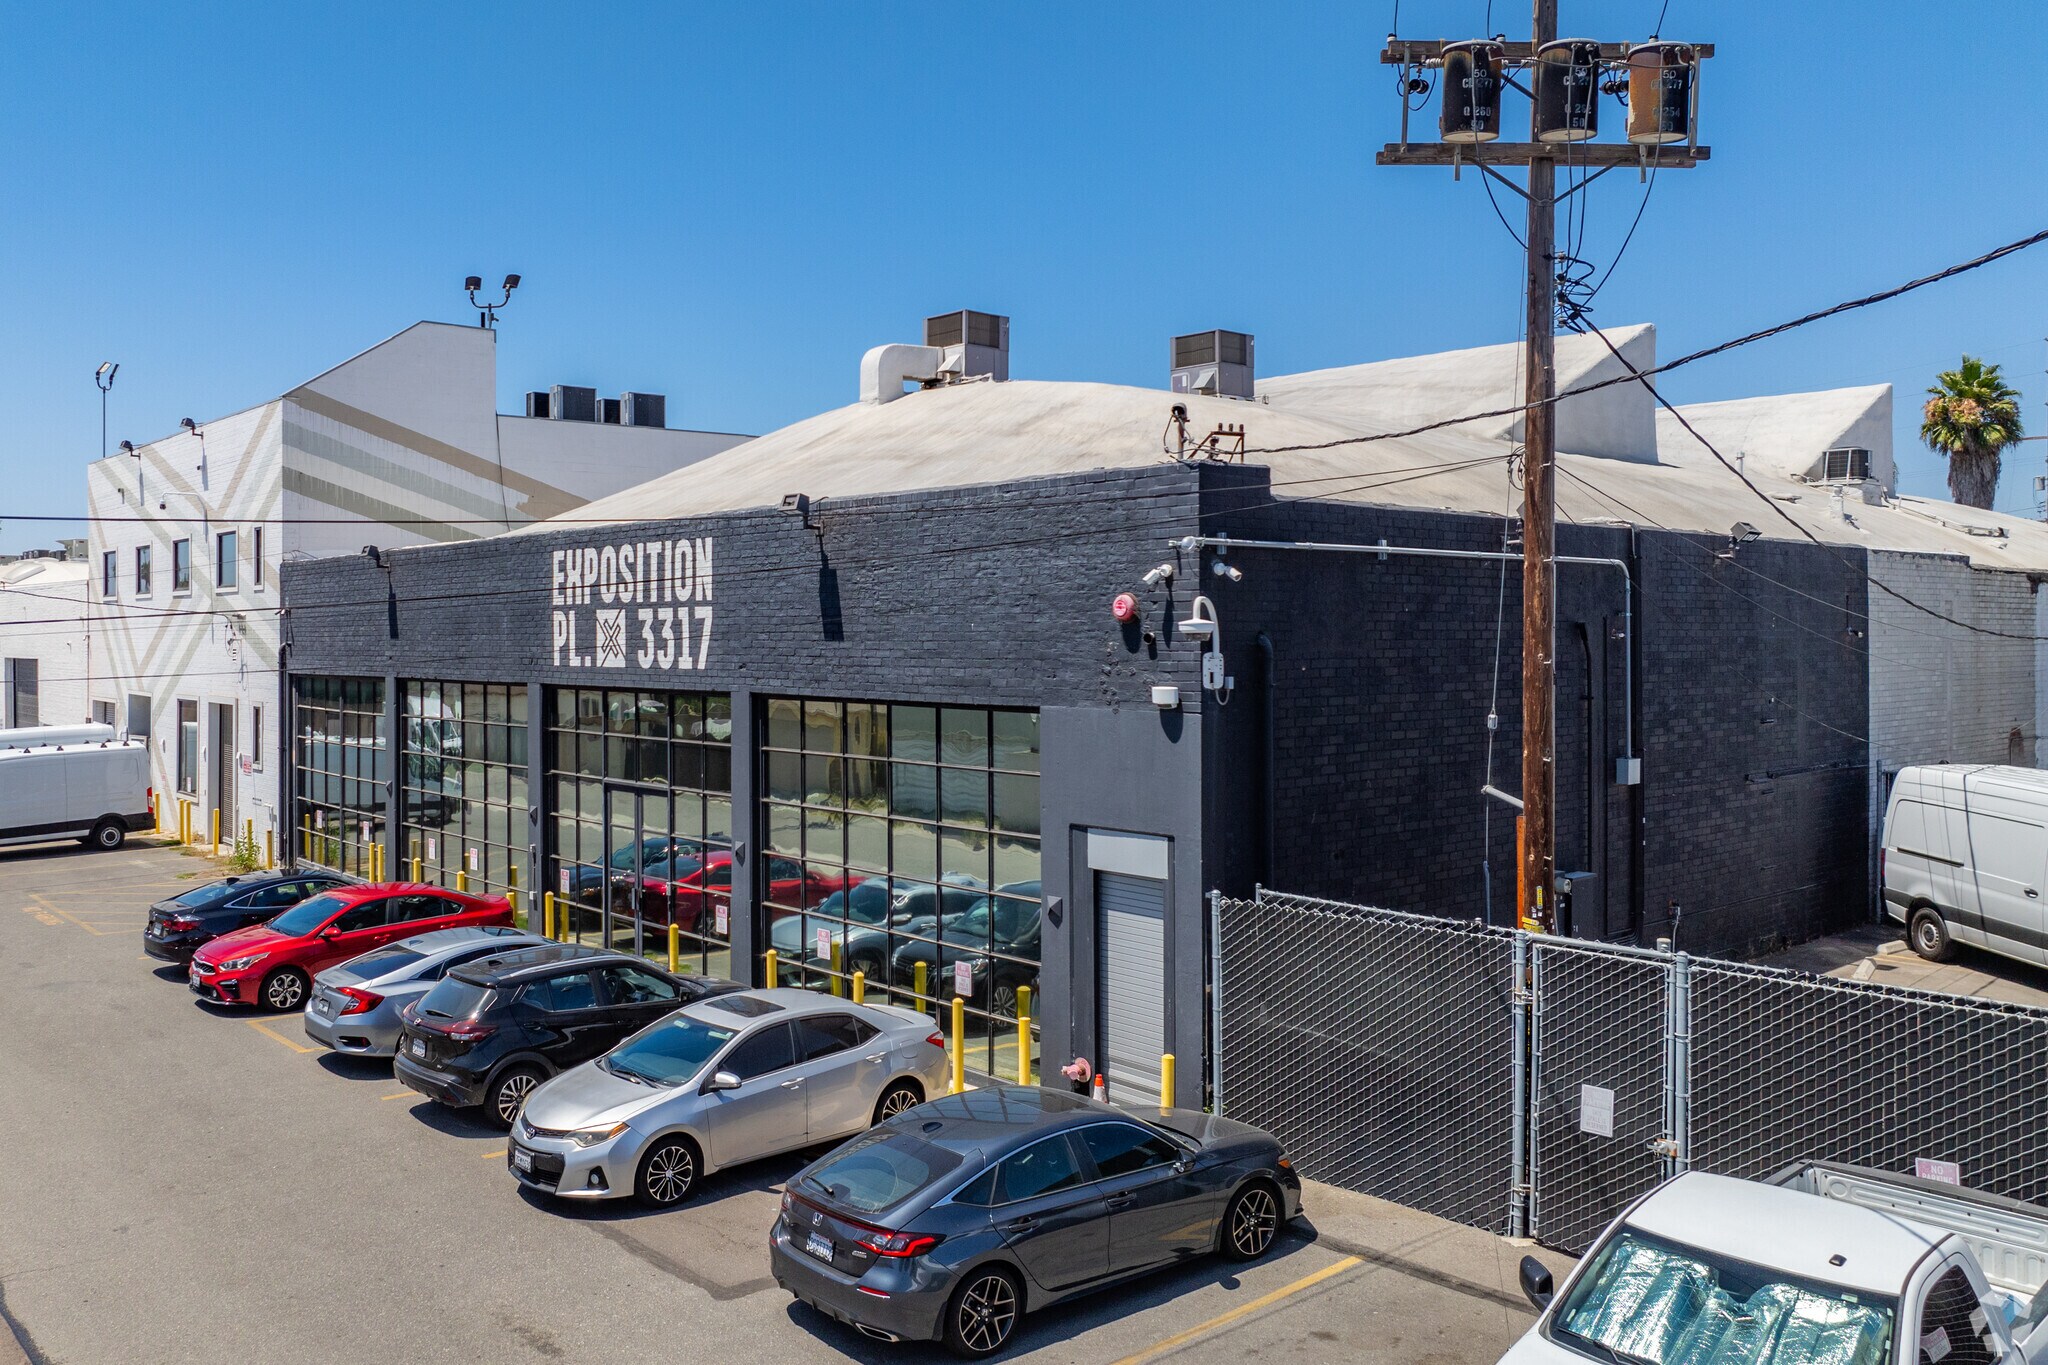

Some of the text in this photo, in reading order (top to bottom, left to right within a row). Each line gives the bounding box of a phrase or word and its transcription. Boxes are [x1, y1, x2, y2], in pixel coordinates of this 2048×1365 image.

[1474, 69, 1487, 78] 50
[1575, 67, 1588, 76] 50
[1662, 70, 1677, 79] 50
[1572, 117, 1586, 127] 50
[552, 537, 713, 605] EXPOSITION
[553, 606, 713, 670] PL. 3317
[1931, 1165, 1944, 1175] NO
[1921, 1173, 1954, 1185] PARKING
